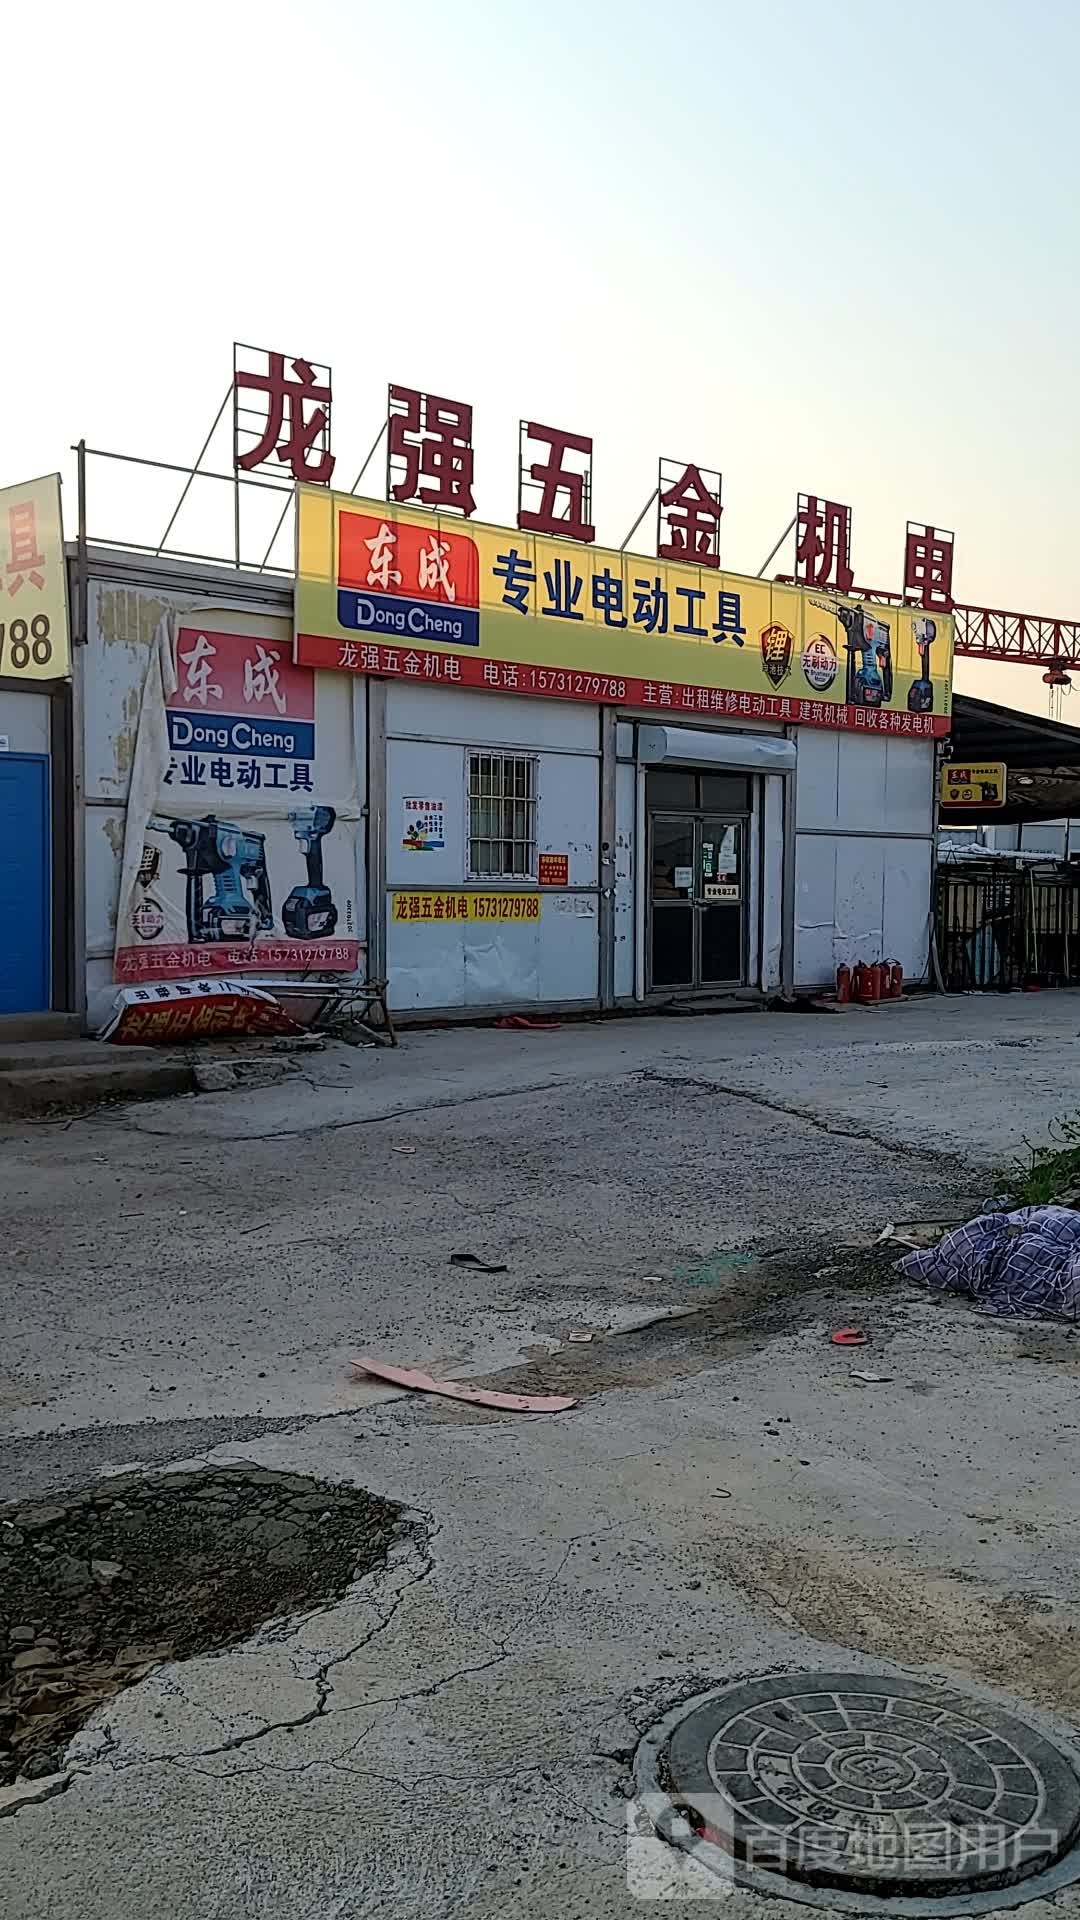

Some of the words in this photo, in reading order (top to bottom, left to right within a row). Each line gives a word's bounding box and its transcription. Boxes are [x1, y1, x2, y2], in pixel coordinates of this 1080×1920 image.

[235, 352, 955, 613] 龙强五金机电
[363, 523, 456, 602] 东成
[492, 548, 747, 648] 专业电动工具
[179, 635, 287, 714] 东成
[766, 628, 788, 661] 锂
[803, 654, 837, 672] 无刷动力
[338, 645, 462, 681] 龙强五金机电
[642, 682, 792, 718] 主营:出租维修电动工具
[799, 701, 848, 725] 建筑机械
[855, 708, 935, 734] 回收各种发电机
[396, 895, 468, 919] 龙强五金机电
[473, 897, 538, 917] 15731279788
[122, 951, 212, 973] 龙强五金机电
